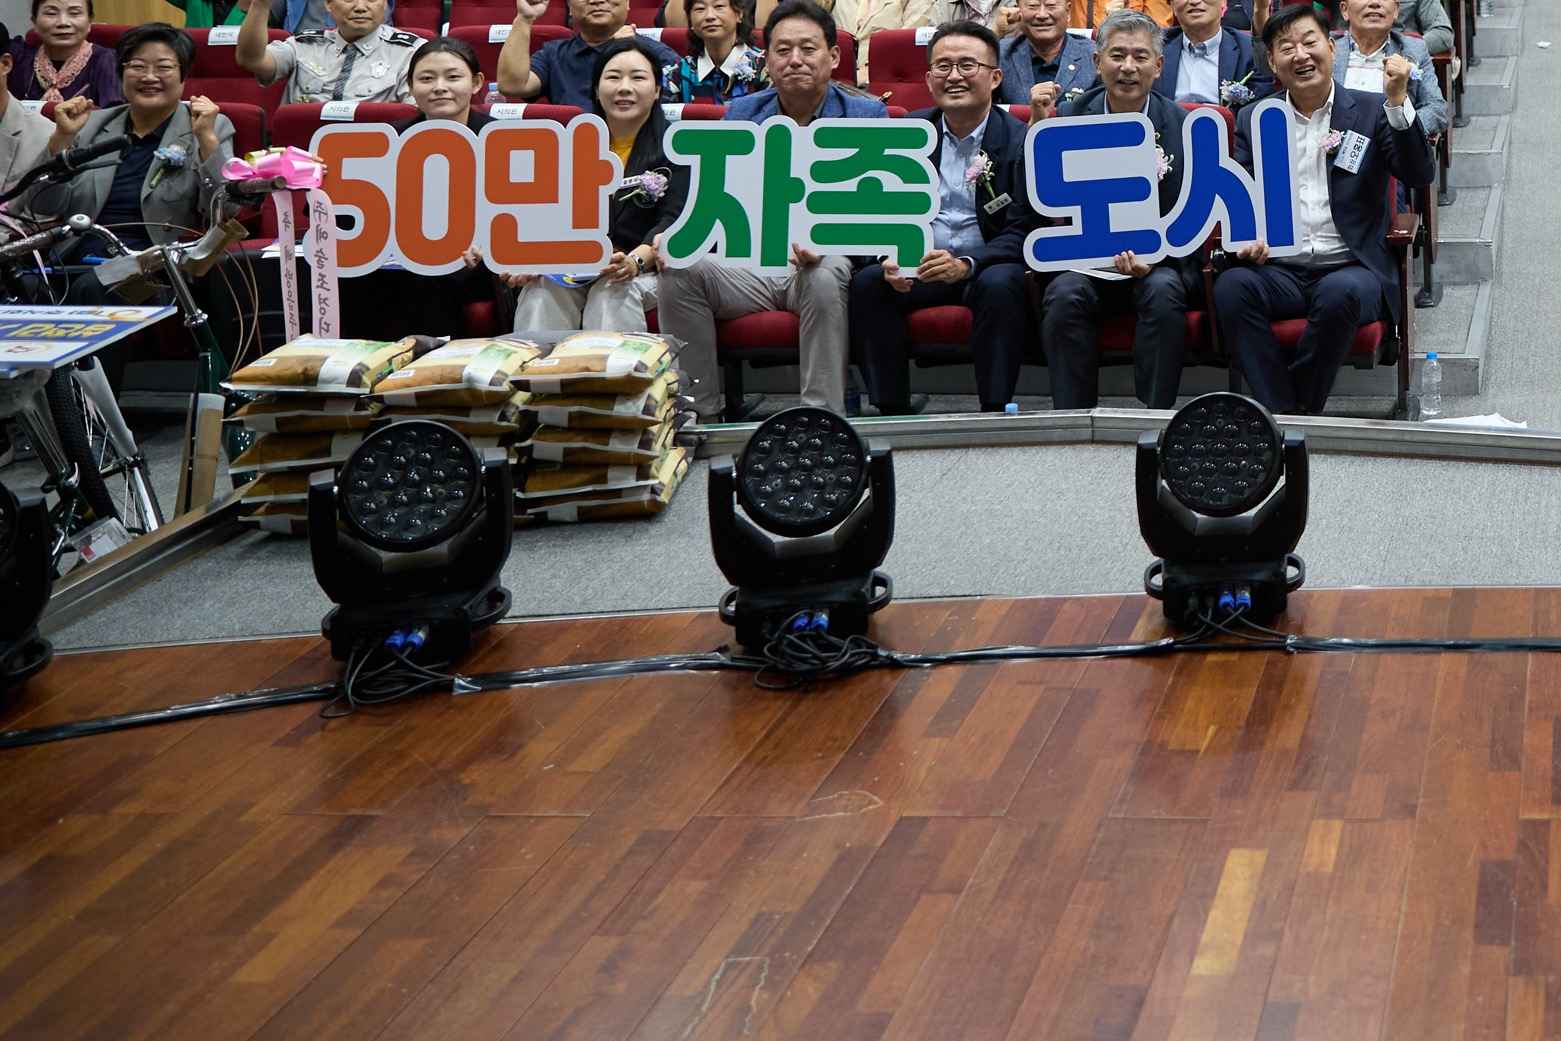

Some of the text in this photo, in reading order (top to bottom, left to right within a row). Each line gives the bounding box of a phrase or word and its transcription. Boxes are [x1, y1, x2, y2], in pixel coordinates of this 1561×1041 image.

[315, 121, 615, 269] 50만
[667, 123, 931, 268] 자족
[1030, 107, 1296, 262] 도시
